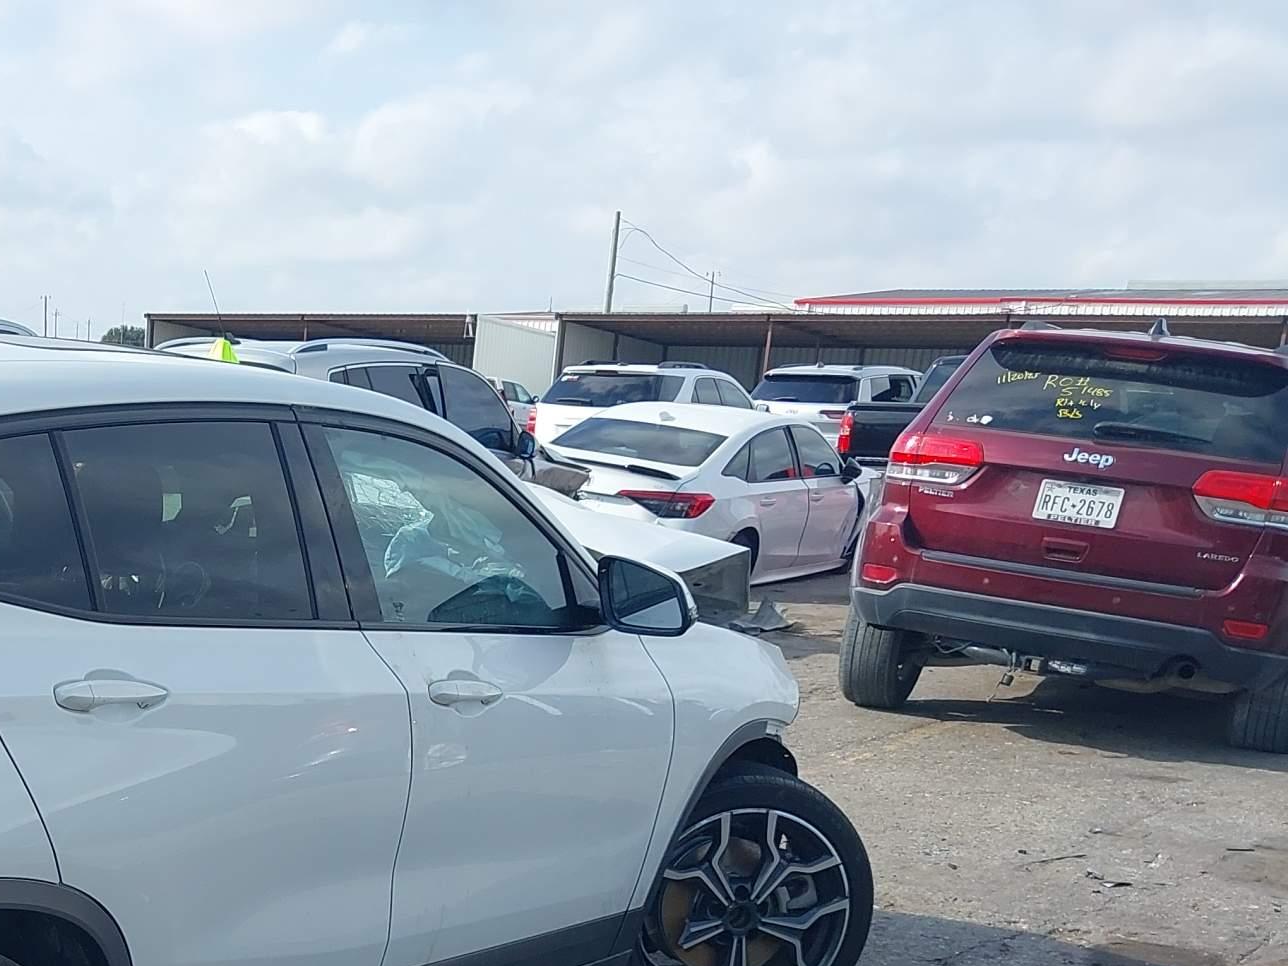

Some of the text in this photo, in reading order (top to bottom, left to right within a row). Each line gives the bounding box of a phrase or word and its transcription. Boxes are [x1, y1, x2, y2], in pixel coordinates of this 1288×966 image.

[1063, 447, 1115, 469] Jeep
[1068, 486, 1098, 497] TEXAS
[1196, 551, 1240, 563] LAREDO
